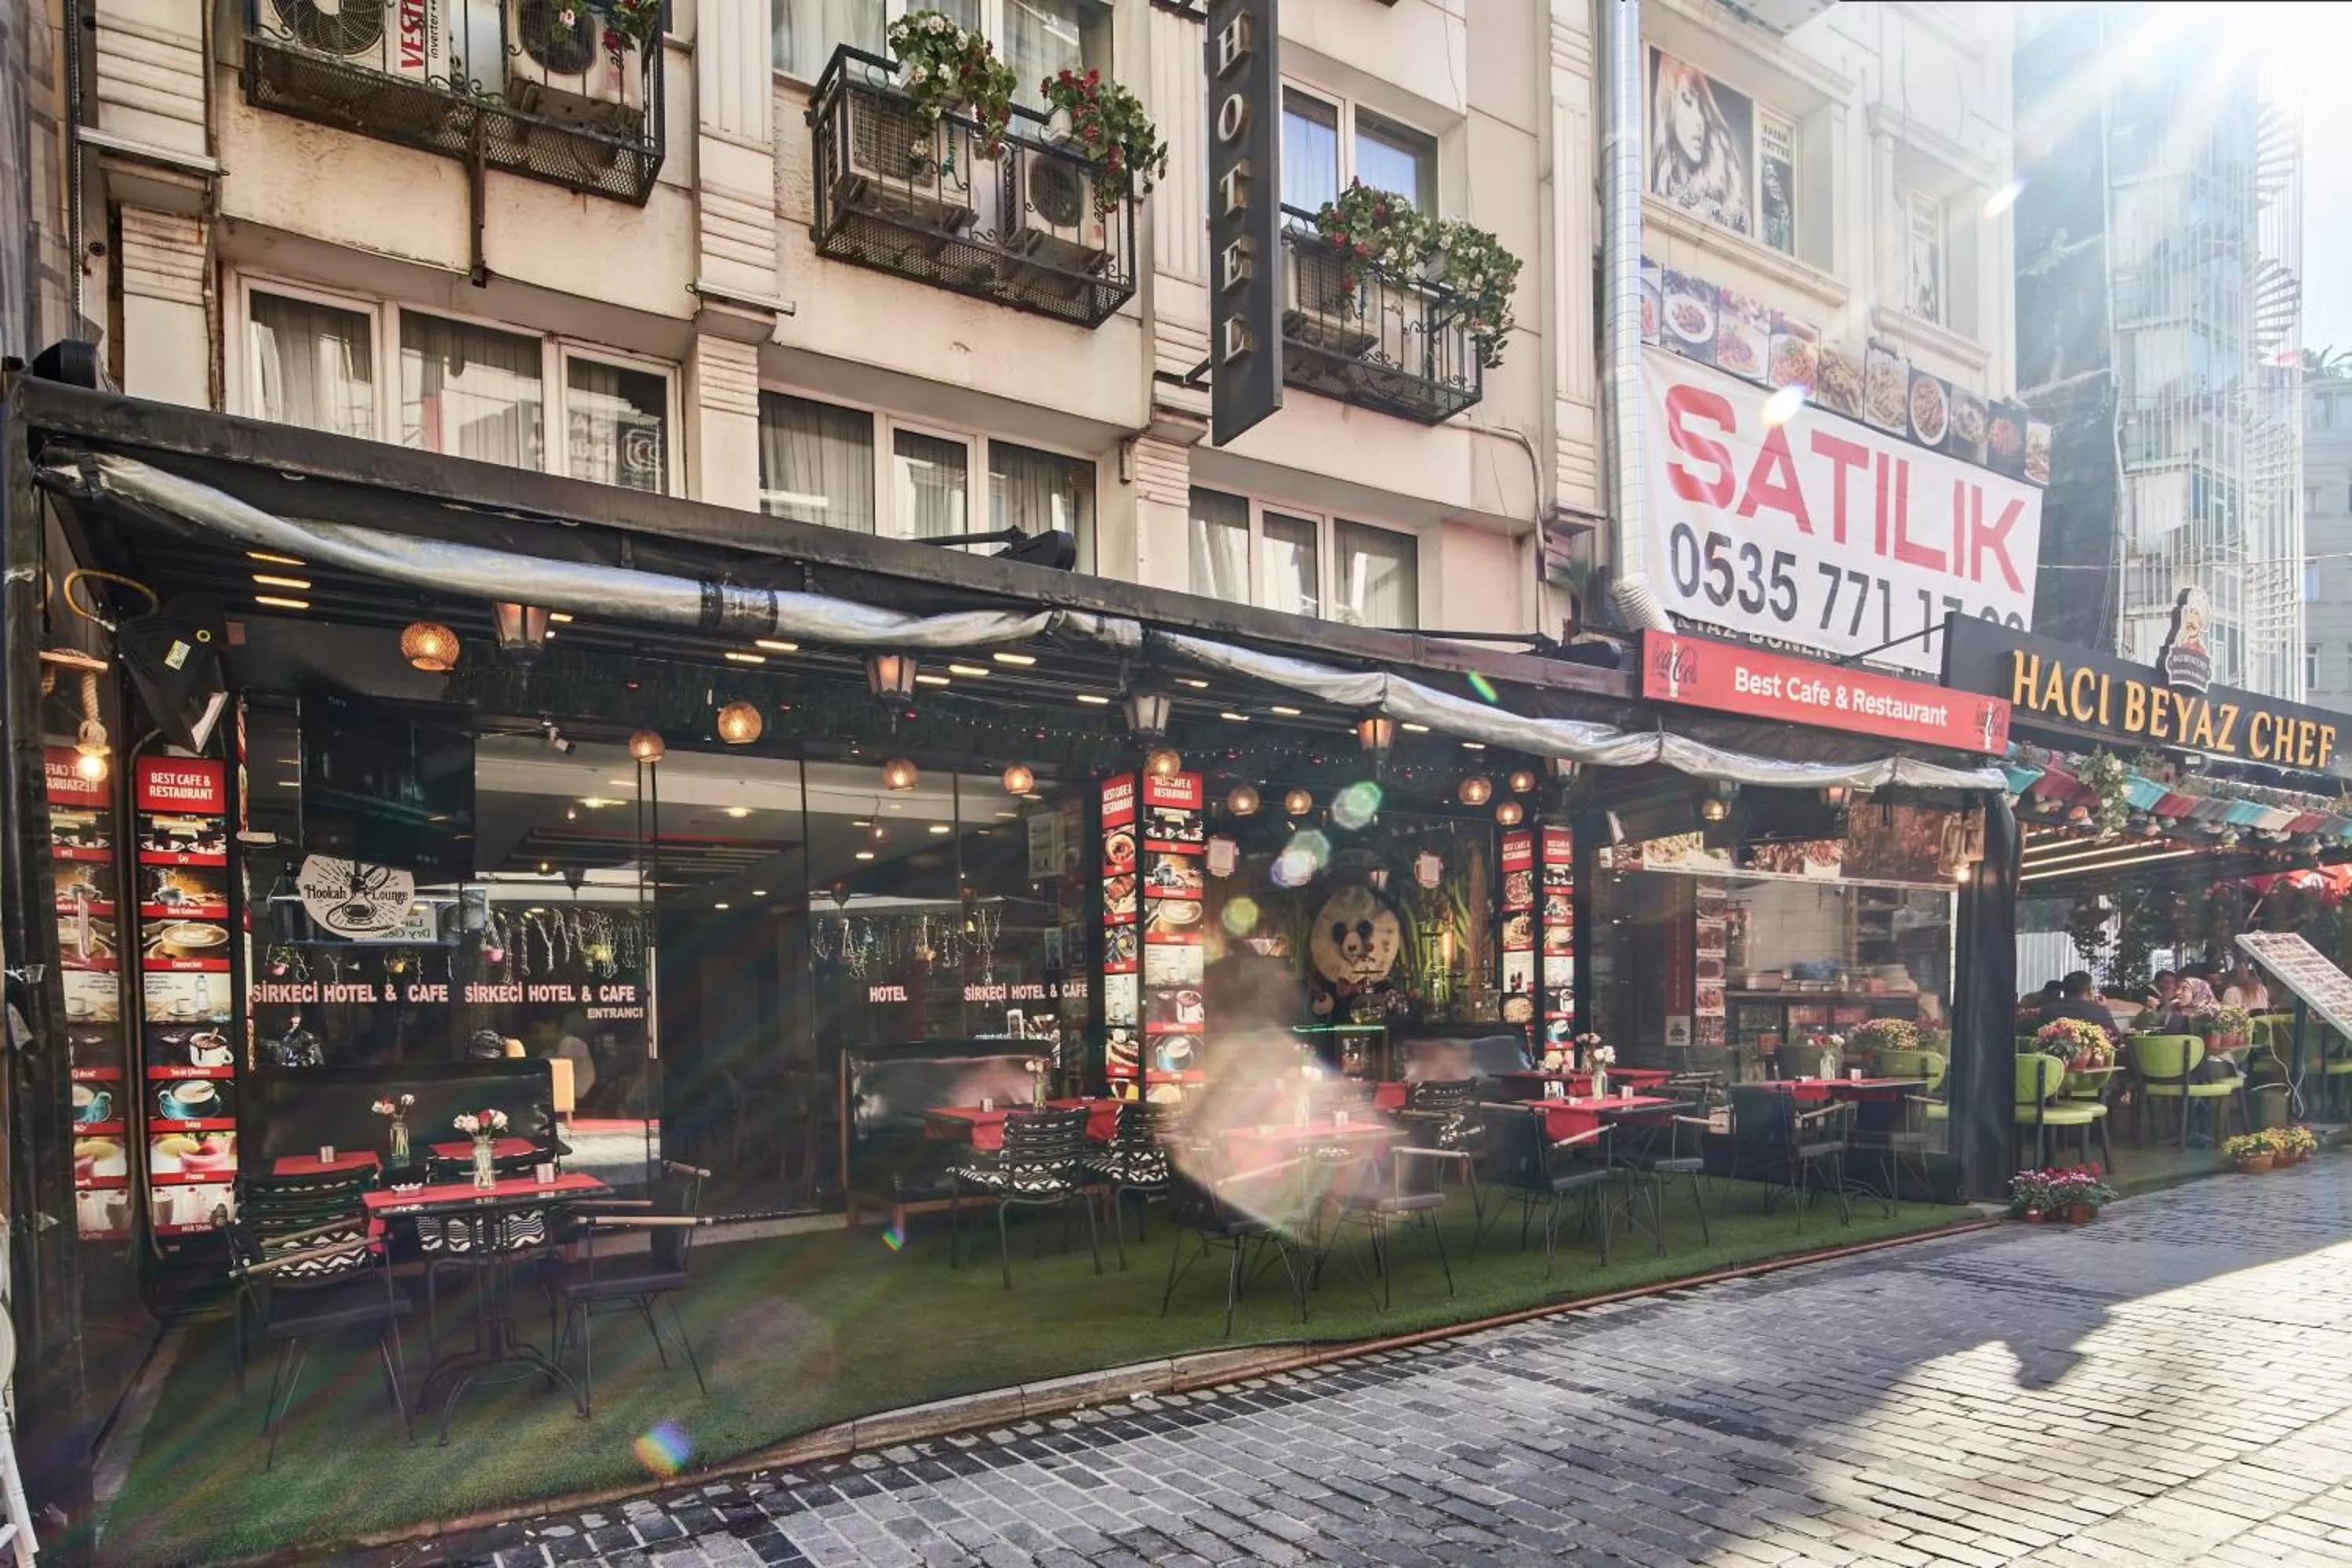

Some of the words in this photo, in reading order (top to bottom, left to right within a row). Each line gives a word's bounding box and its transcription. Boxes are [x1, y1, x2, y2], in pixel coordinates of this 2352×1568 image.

[1216, 7, 1251, 364] HOTEL
[1665, 384, 2027, 595] SATILIK
[1670, 521, 1798, 624] 0535
[1818, 561, 1892, 646] 771
[1734, 666, 1781, 698] Best
[1786, 677, 1831, 707] Cafe
[1835, 688, 1849, 710] &
[1852, 688, 1949, 728] Restaurant
[2012, 649, 2110, 726] HACI
[2124, 680, 2240, 753] BEYAZ
[2248, 710, 2336, 769] CHEF
[151, 772, 176, 785] BEST
[176, 774, 202, 786] CAFE
[203, 775, 212, 786] &
[150, 786, 214, 800] RESTAURANT
[304, 884, 347, 899] Hookah
[368, 887, 408, 905] Lounge
[252, 980, 319, 1003] SİRKECİ
[323, 984, 377, 1003] HOTEL
[384, 984, 397, 1003] &
[408, 984, 449, 1003] CAFE
[465, 981, 522, 1003] SİRKECİ
[528, 985, 575, 1003] HOTEL
[581, 985, 593, 1003] &
[599, 985, 636, 1003] CAFE
[869, 985, 908, 1003] HOTEL
[964, 982, 1007, 1002] SİRKECİ
[1011, 985, 1044, 1000] HOTEL
[1049, 984, 1058, 998] &
[1062, 983, 1088, 1000] CAFE
